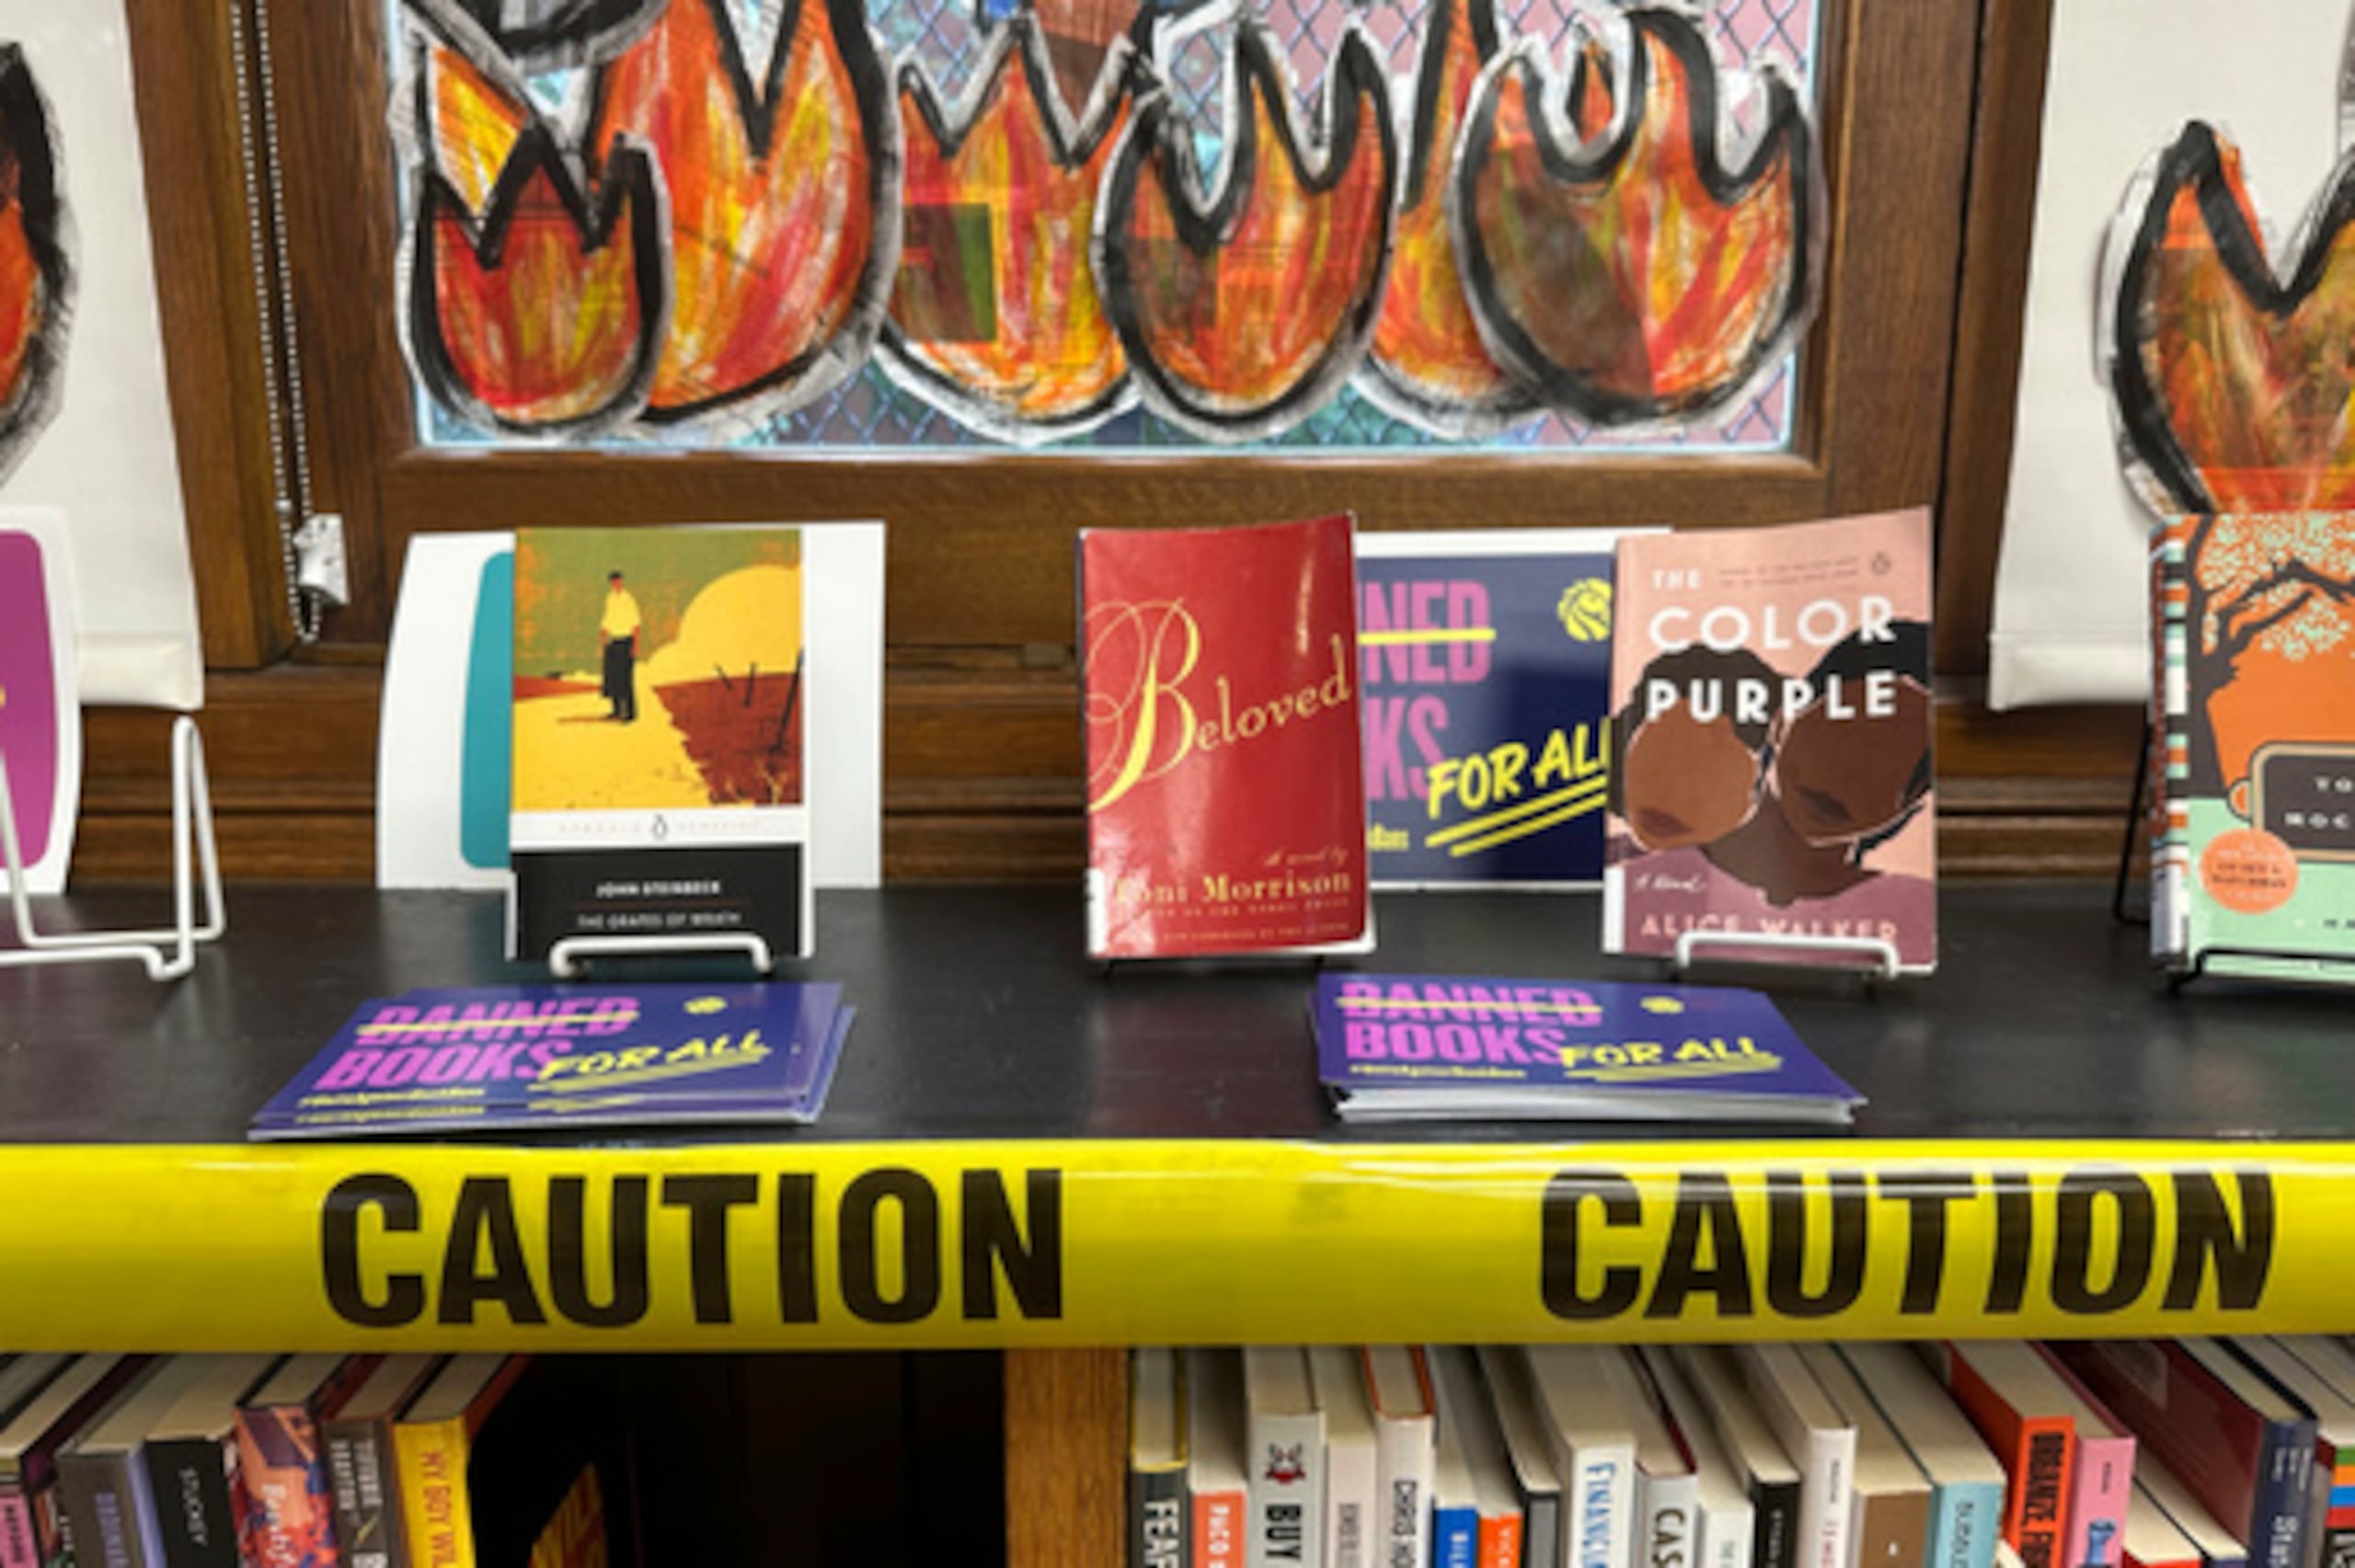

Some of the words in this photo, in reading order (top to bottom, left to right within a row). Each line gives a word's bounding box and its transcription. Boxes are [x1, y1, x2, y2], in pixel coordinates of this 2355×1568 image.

[1652, 569, 1700, 589] THE
[1648, 596, 1897, 654] COLOR
[1086, 596, 1350, 812] Beloved
[1646, 670, 1897, 723] PURPLE
[1427, 742, 1528, 819] FOR
[1202, 870, 1350, 904] Morrison
[1641, 915, 1739, 937] ALICE
[1760, 917, 1898, 941] WALKER
[356, 997, 640, 1047] BANNED
[1338, 981, 1602, 1027] BANNED
[312, 1038, 572, 1091] BOOKS
[536, 1046, 661, 1082] FOR
[666, 1029, 764, 1064] ALL
[1344, 1021, 1568, 1065] BOOKS
[1561, 1040, 1664, 1069] FOR
[1674, 1036, 1759, 1061] ALL
[319, 1167, 1064, 1328] CAUTION
[1537, 1167, 2279, 1321] CAUTION
[419, 1450, 443, 1481] MY
[422, 1485, 452, 1528] BOY
[1265, 1504, 1303, 1562] BUY
